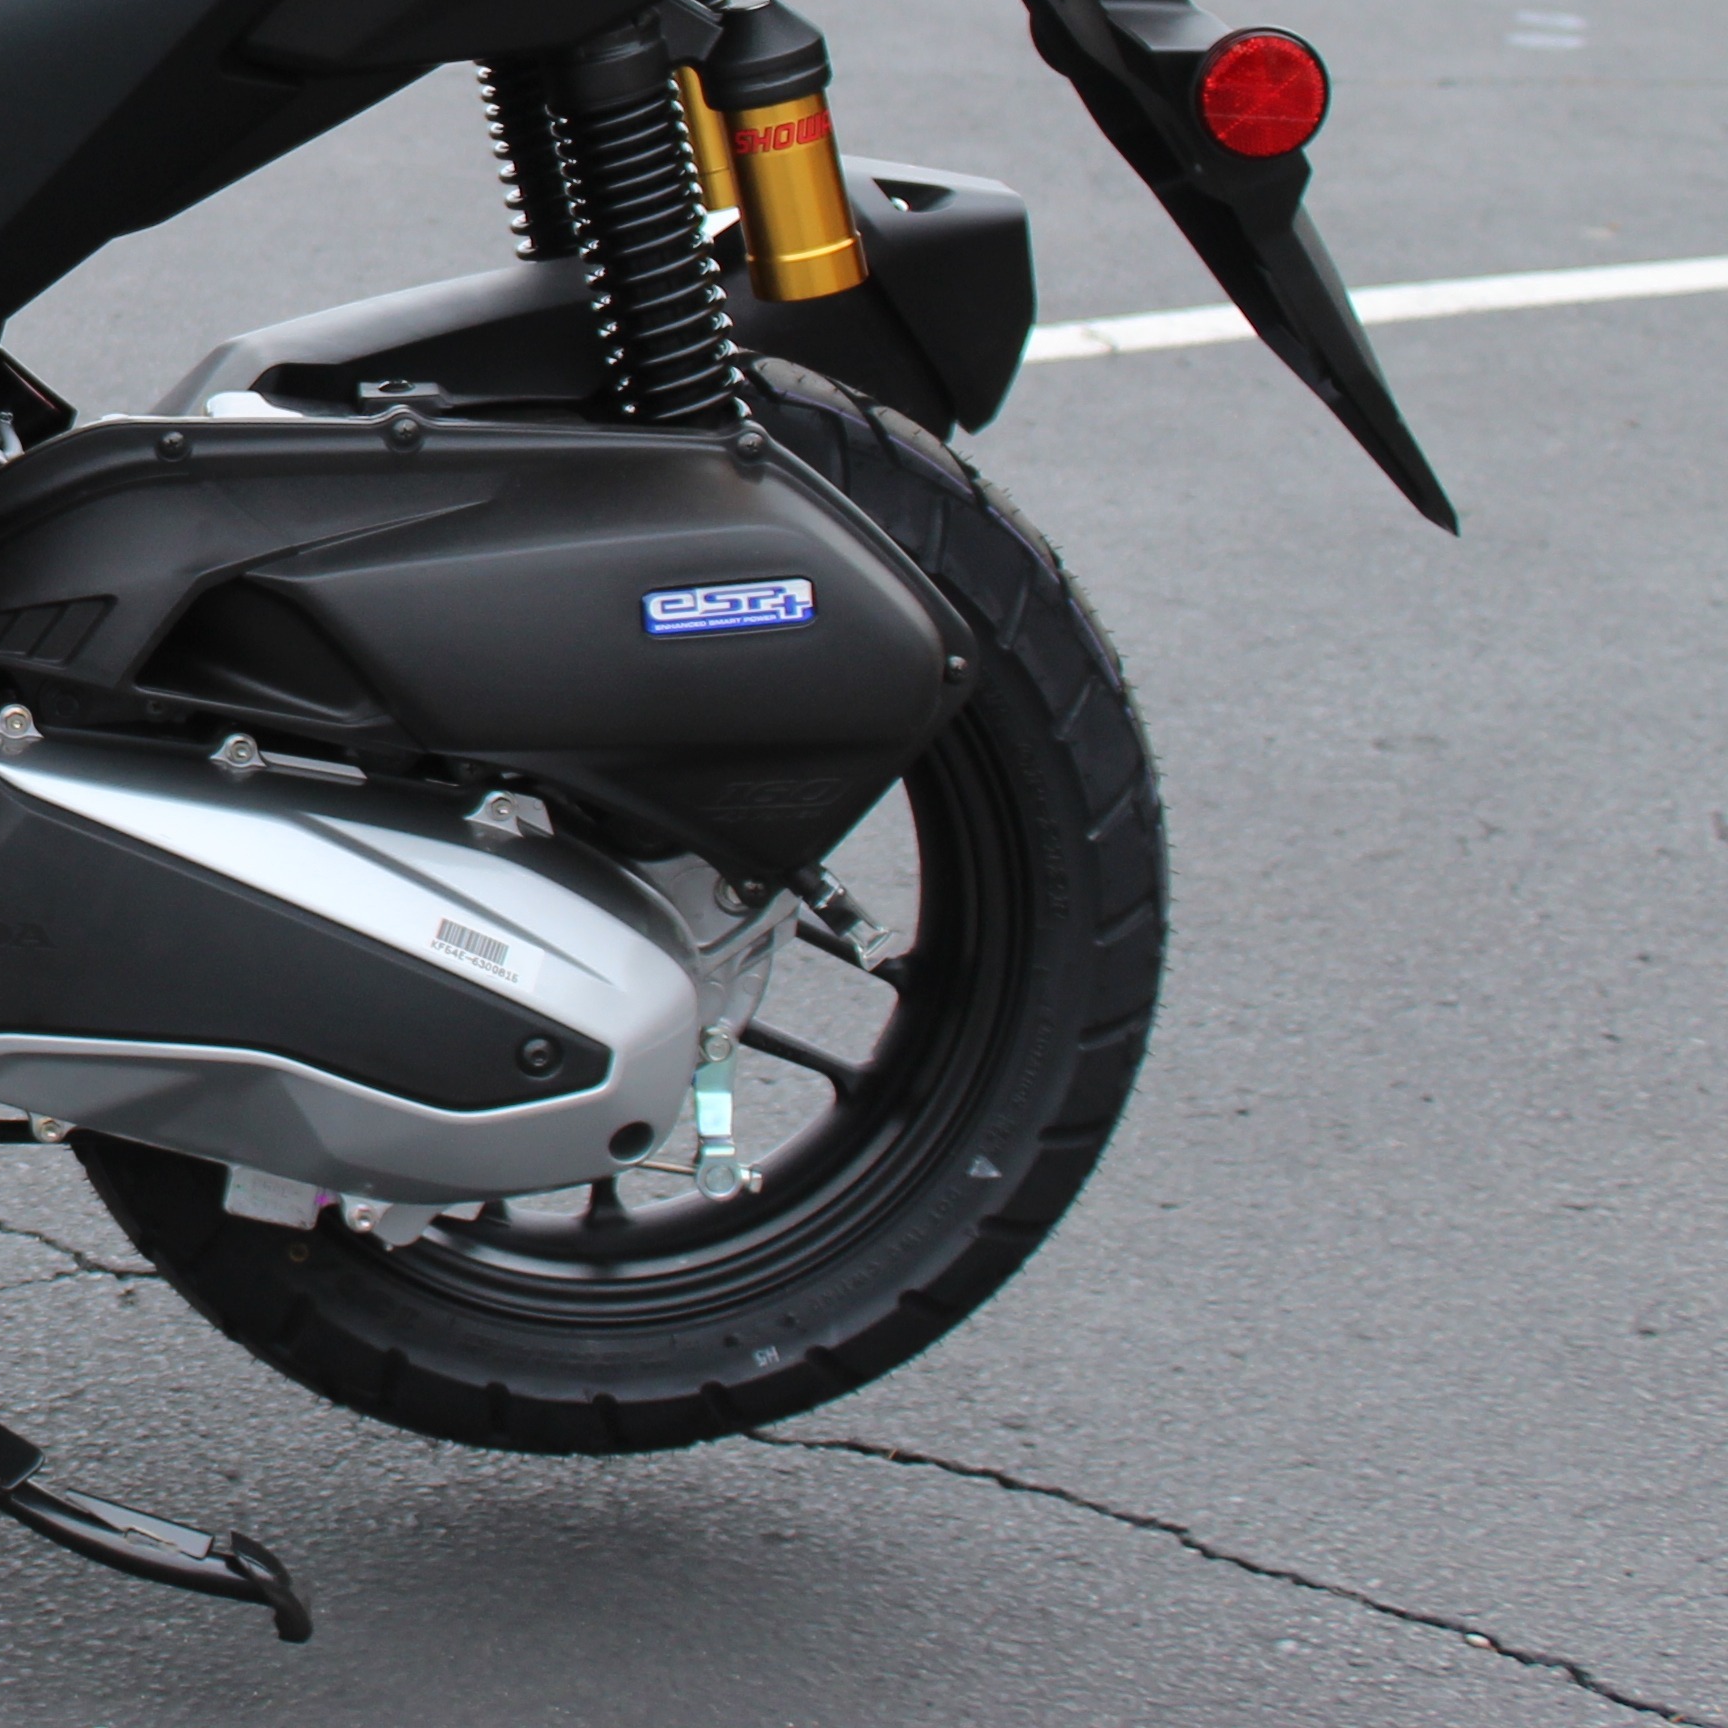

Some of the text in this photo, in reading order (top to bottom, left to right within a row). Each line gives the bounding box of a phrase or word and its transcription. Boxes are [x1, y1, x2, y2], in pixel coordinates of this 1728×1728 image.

[654, 614, 777, 631] ENHANCED SMART POWER
